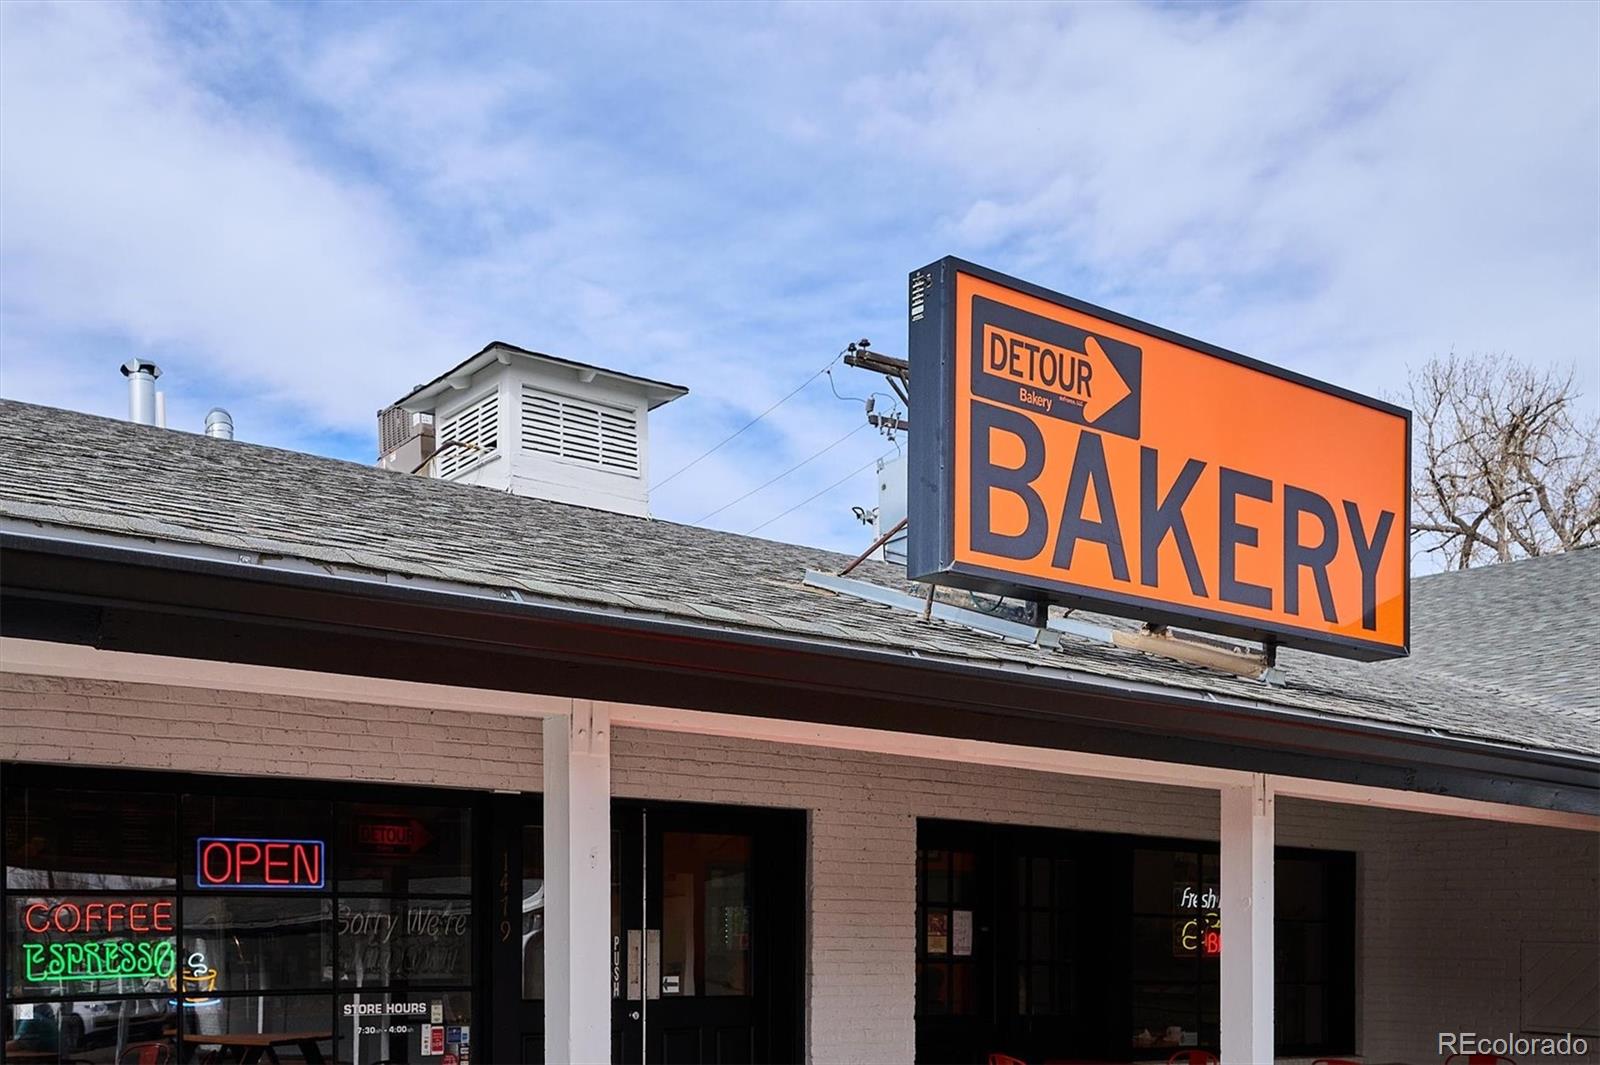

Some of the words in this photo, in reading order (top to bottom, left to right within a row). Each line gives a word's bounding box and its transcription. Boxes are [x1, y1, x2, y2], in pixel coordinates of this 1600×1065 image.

[990, 332, 1093, 398] DETOUR
[1019, 387, 1053, 412] Bakery
[969, 398, 1395, 631] BAKERY
[203, 842, 319, 884] OPEN
[25, 902, 173, 933] COFFEE
[338, 904, 399, 943] Sorry
[23, 941, 176, 982] ESPRESSO
[613, 935, 621, 998] PUSH
[343, 1003, 382, 1015] STORE
[386, 1002, 427, 1014] HOURS
